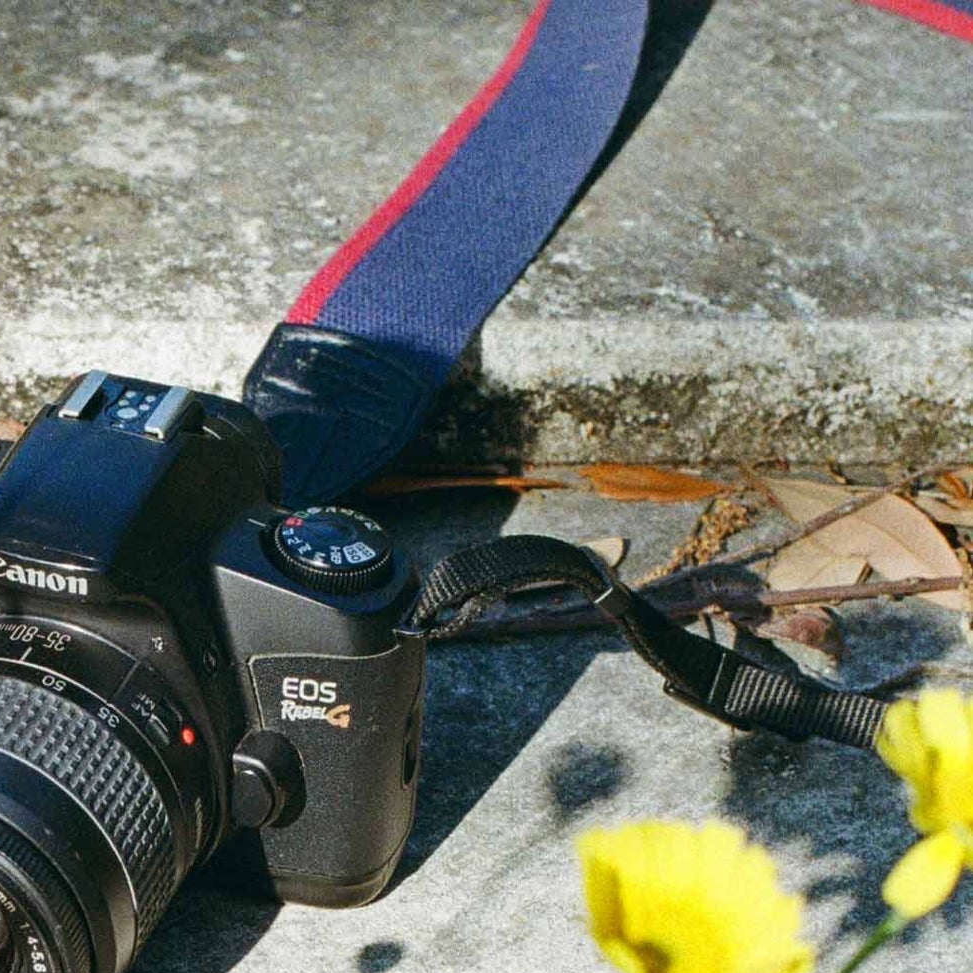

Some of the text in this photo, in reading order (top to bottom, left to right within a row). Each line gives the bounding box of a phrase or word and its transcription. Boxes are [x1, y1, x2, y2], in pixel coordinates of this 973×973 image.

[41, 674, 67, 692] 50
[282, 676, 337, 703] EOS
[97, 706, 121, 728] 35
